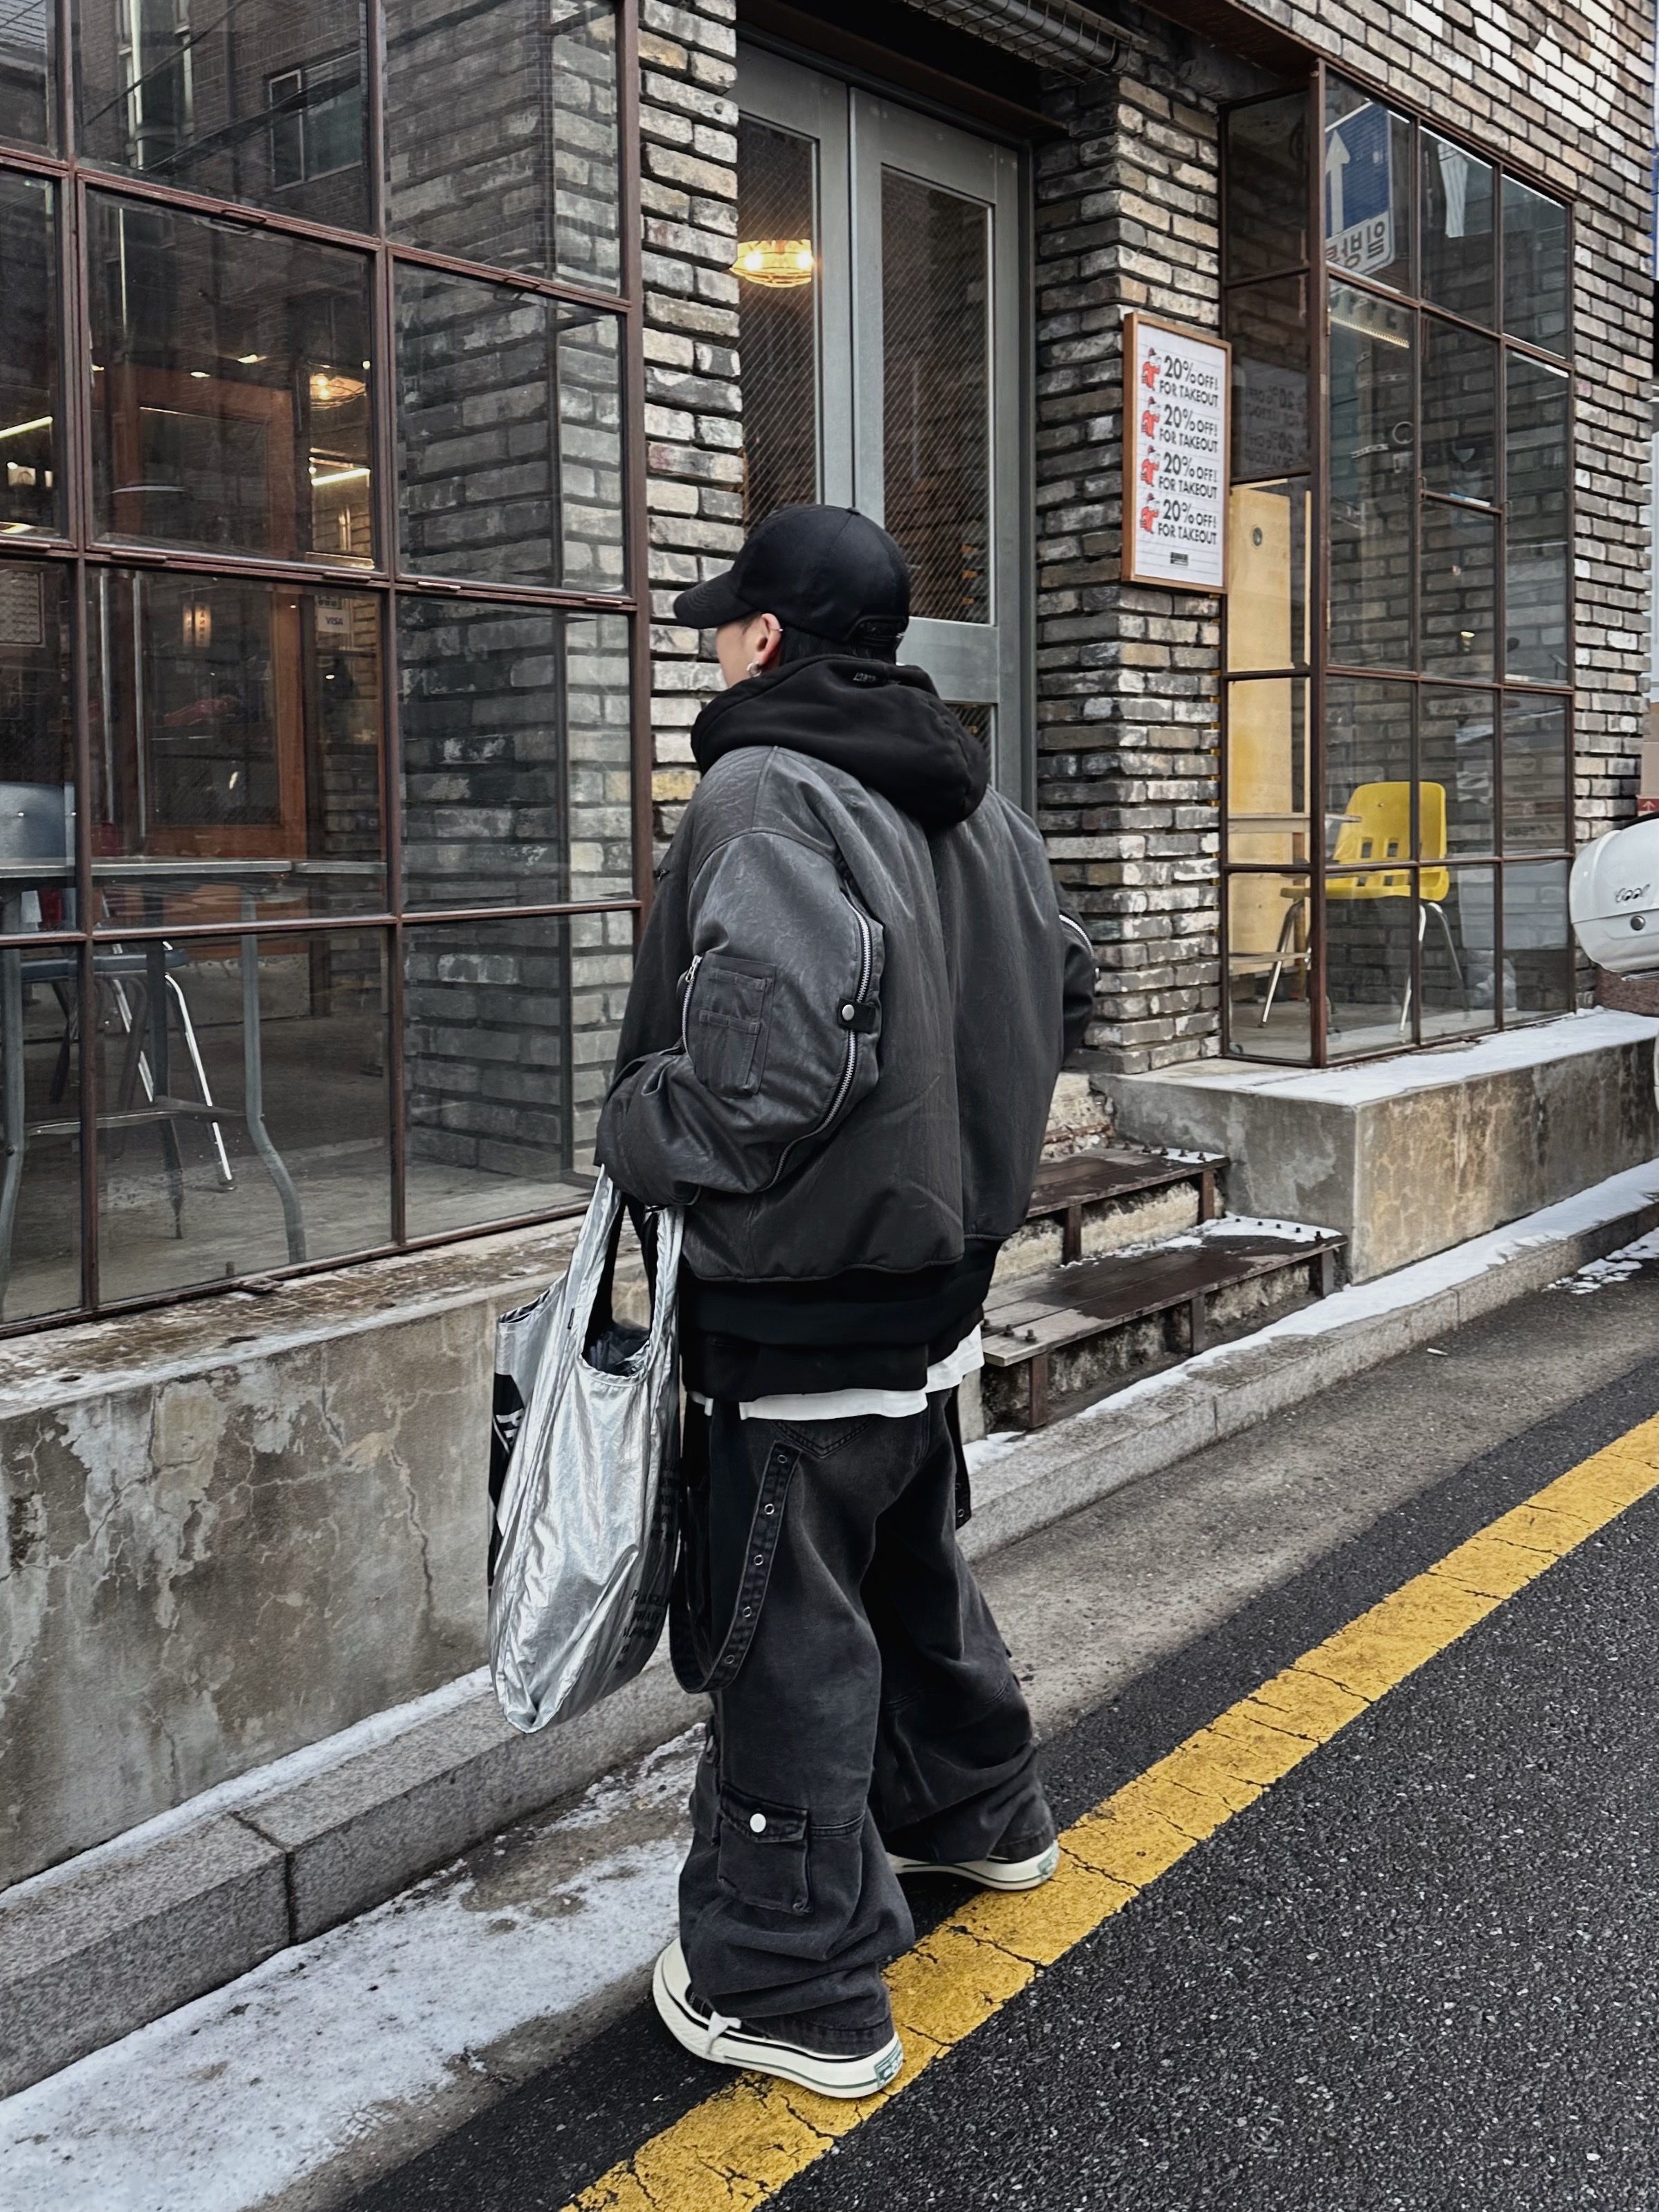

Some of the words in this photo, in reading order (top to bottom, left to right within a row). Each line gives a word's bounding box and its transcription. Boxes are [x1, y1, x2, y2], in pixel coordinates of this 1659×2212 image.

[1163, 355, 1196, 384] 20%
[1197, 373, 1218, 391] OFF!
[1159, 380, 1177, 397] FOR
[1179, 385, 1219, 407] TAKEOUT
[1163, 404, 1195, 432] 20%
[1197, 419, 1217, 437] OFF!
[1159, 428, 1177, 445] FOR
[1179, 433, 1218, 454] TAKEOUT
[1163, 452, 1195, 478] 20%
[1197, 466, 1217, 483] OFF!
[1159, 475, 1177, 492] FOR
[1178, 480, 1217, 499] TAKEOUT
[1163, 498, 1195, 524] 20%
[1196, 513, 1217, 529] OFF!
[1157, 523, 1176, 538] FOR
[1178, 526, 1217, 545] TAKEOUT
[325, 616, 344, 626] VISA
